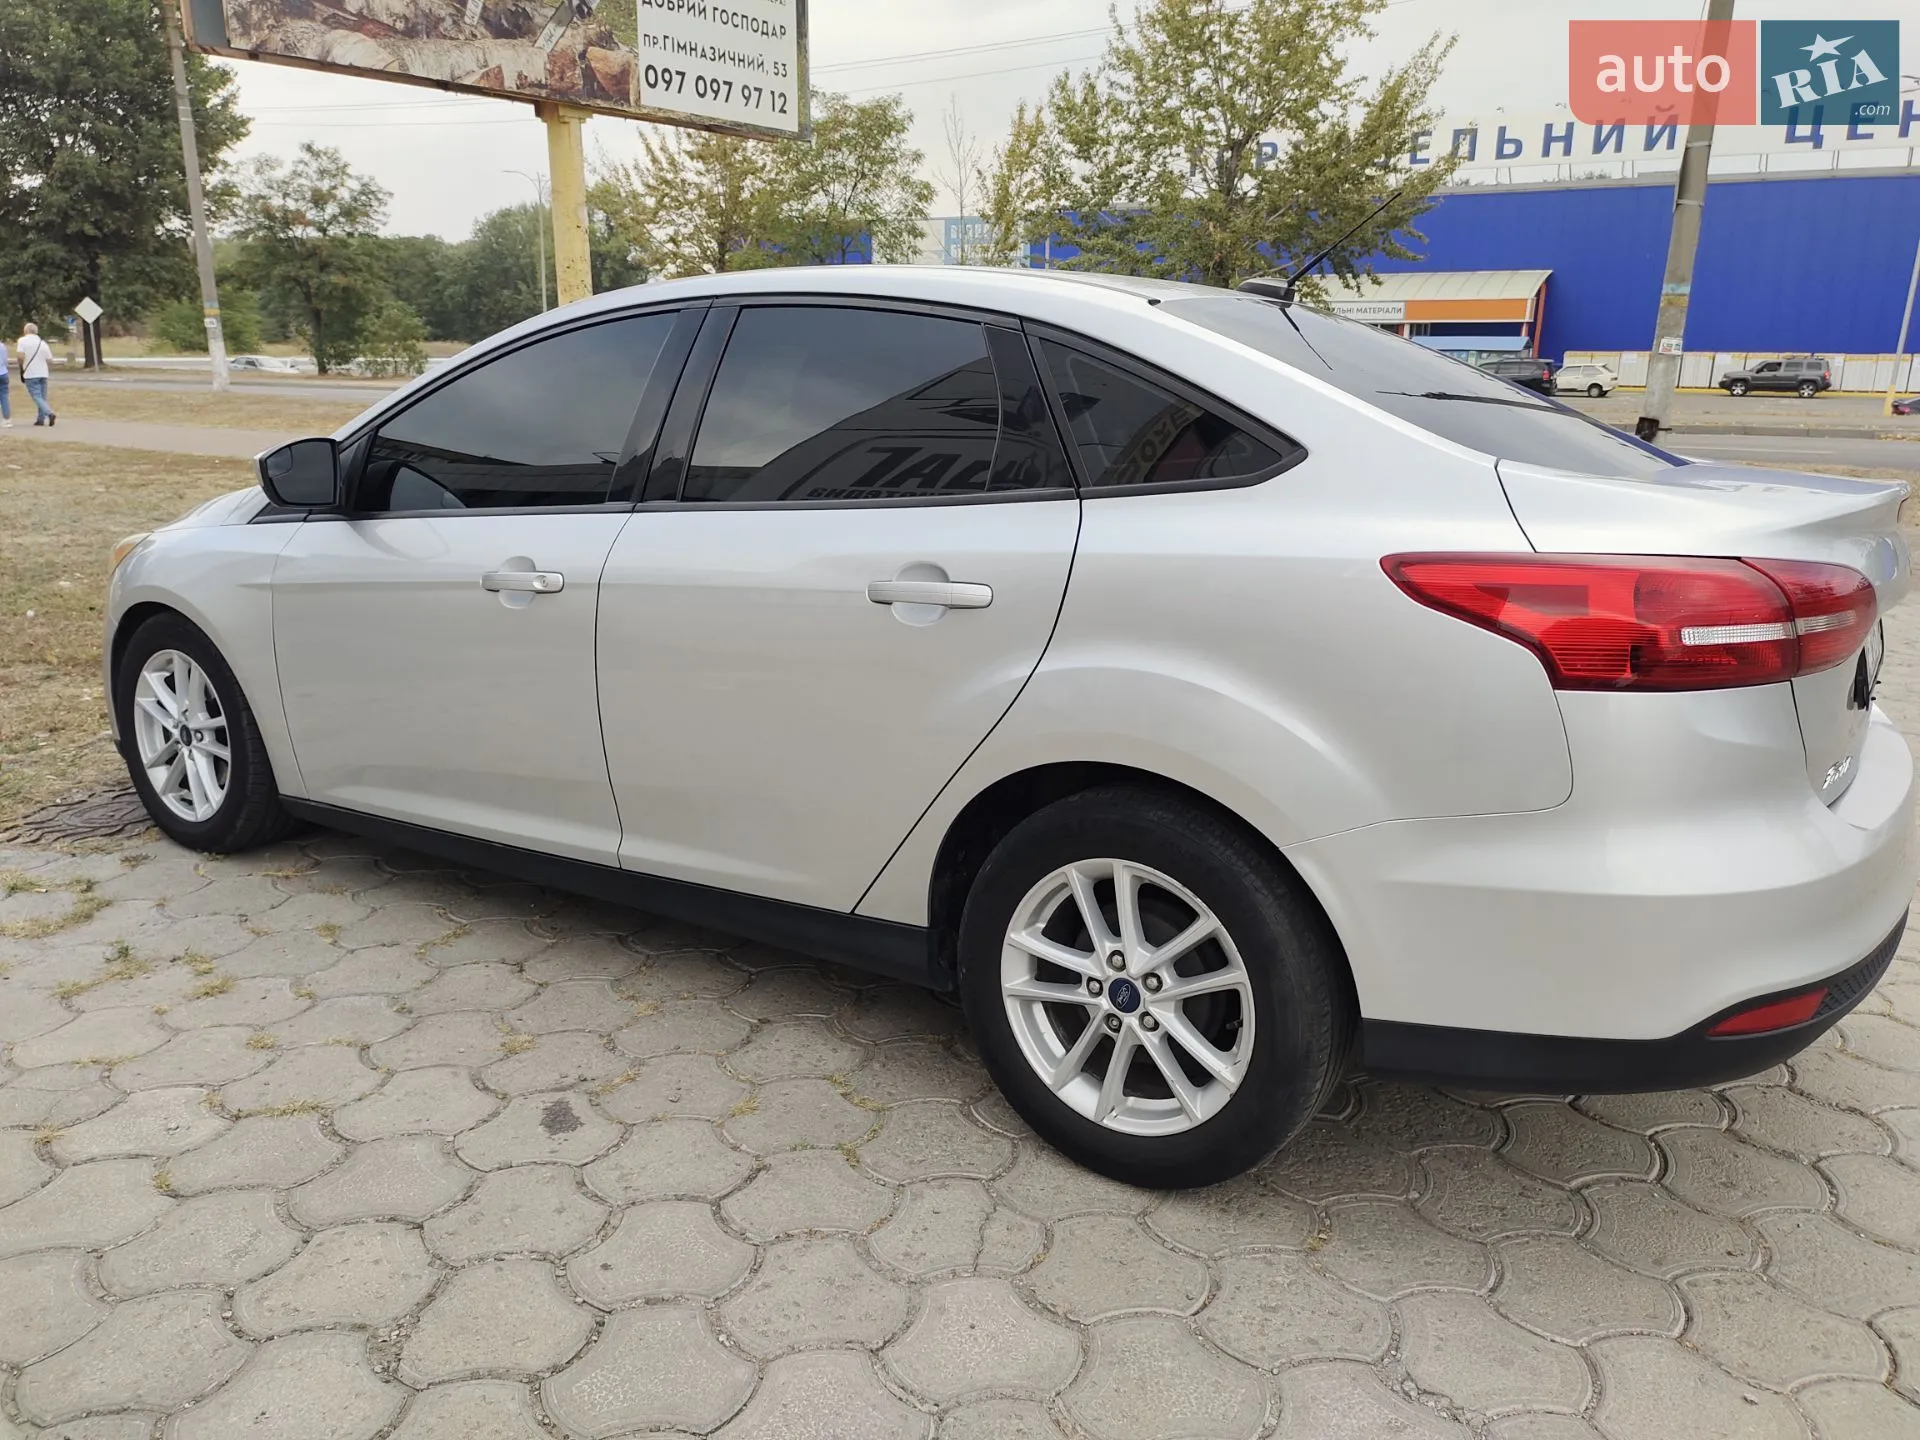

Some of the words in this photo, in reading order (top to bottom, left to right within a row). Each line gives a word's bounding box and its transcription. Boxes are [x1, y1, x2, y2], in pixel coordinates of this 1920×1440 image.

[712, 7, 787, 40] ГОСПОДАР
[773, 61, 788, 78] 53
[645, 64, 686, 94] 097
[695, 75, 733, 103] 097
[741, 84, 763, 109] 97
[769, 90, 788, 114] 12
[1356, 306, 1402, 315] МАТЕРІАЛИ
